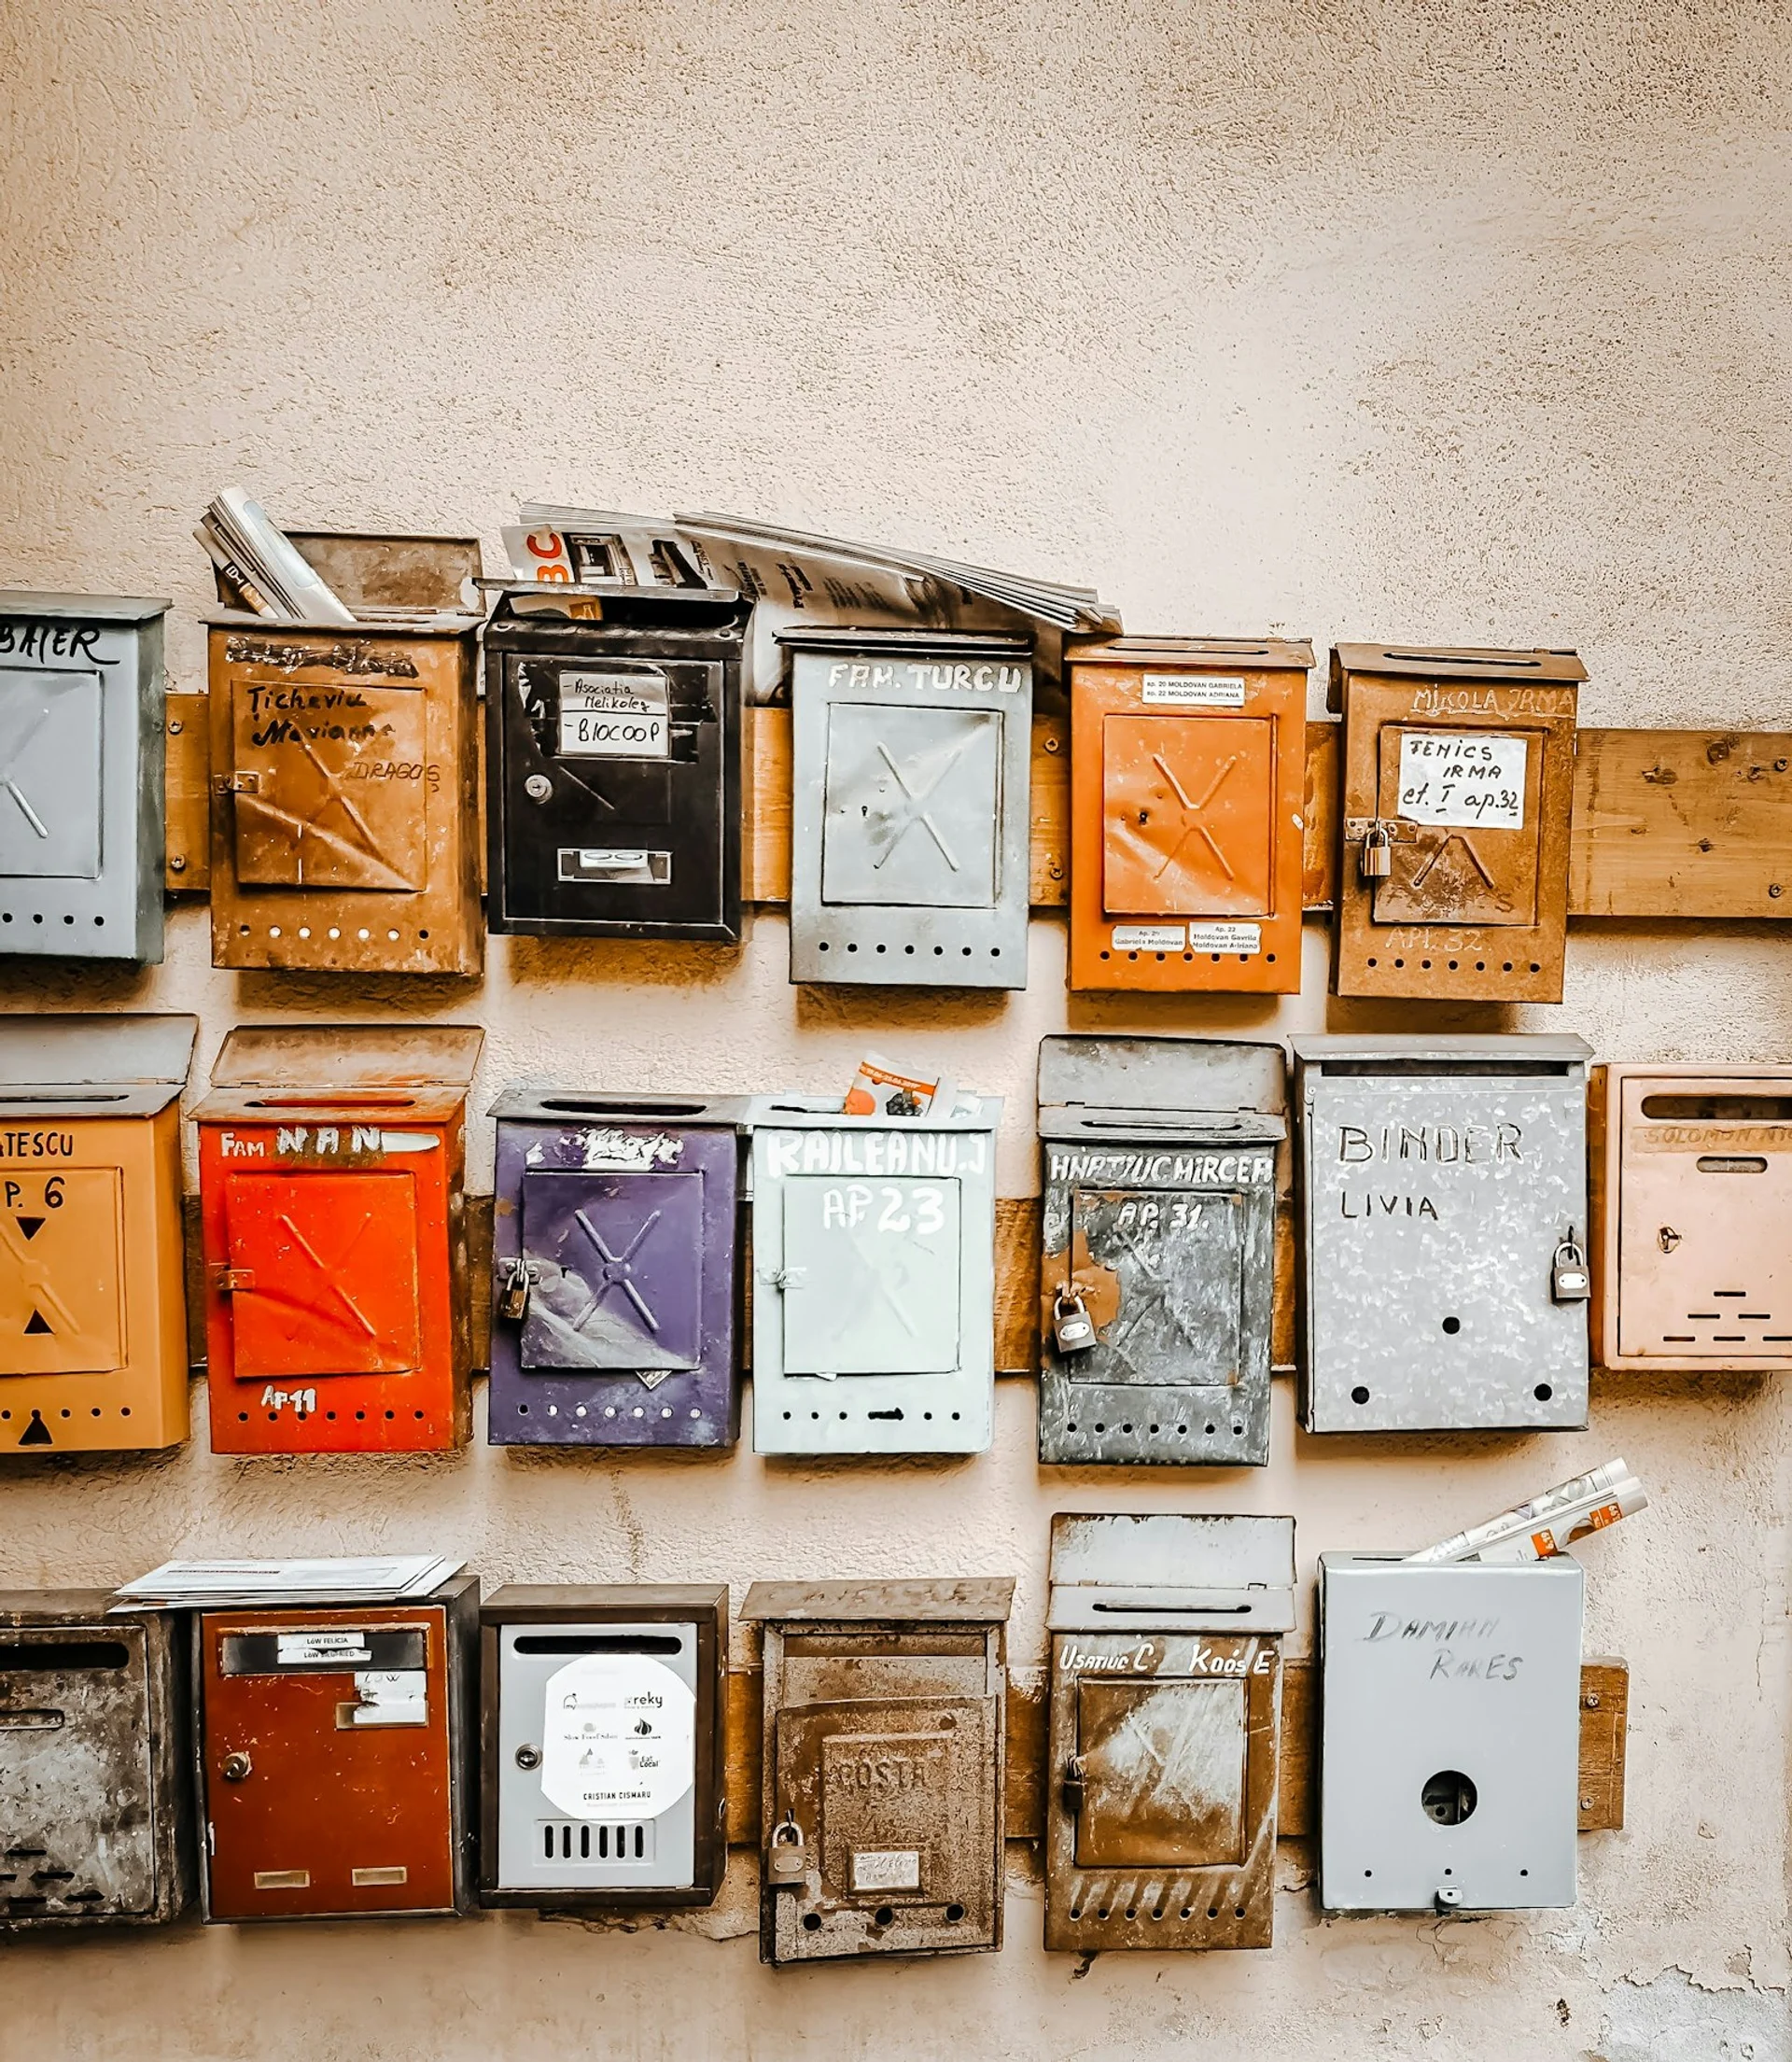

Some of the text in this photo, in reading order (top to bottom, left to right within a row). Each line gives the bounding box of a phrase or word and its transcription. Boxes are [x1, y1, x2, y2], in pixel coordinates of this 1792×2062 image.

[906, 664, 1022, 694] TURCU
[579, 718, 659, 742] BIOCOOP
[1443, 764, 1502, 779] IRMA
[1403, 782, 1429, 806] et.
[0, 1131, 74, 1157] TESCU
[1339, 1122, 1525, 1164] BINDER
[44, 1175, 66, 1209] 6
[1341, 1191, 1438, 1220] LIVIA
[876, 1185, 946, 1235] 23
[1253, 1649, 1275, 1676] E
[583, 1791, 651, 1801] CRISTIAN CISMARU
